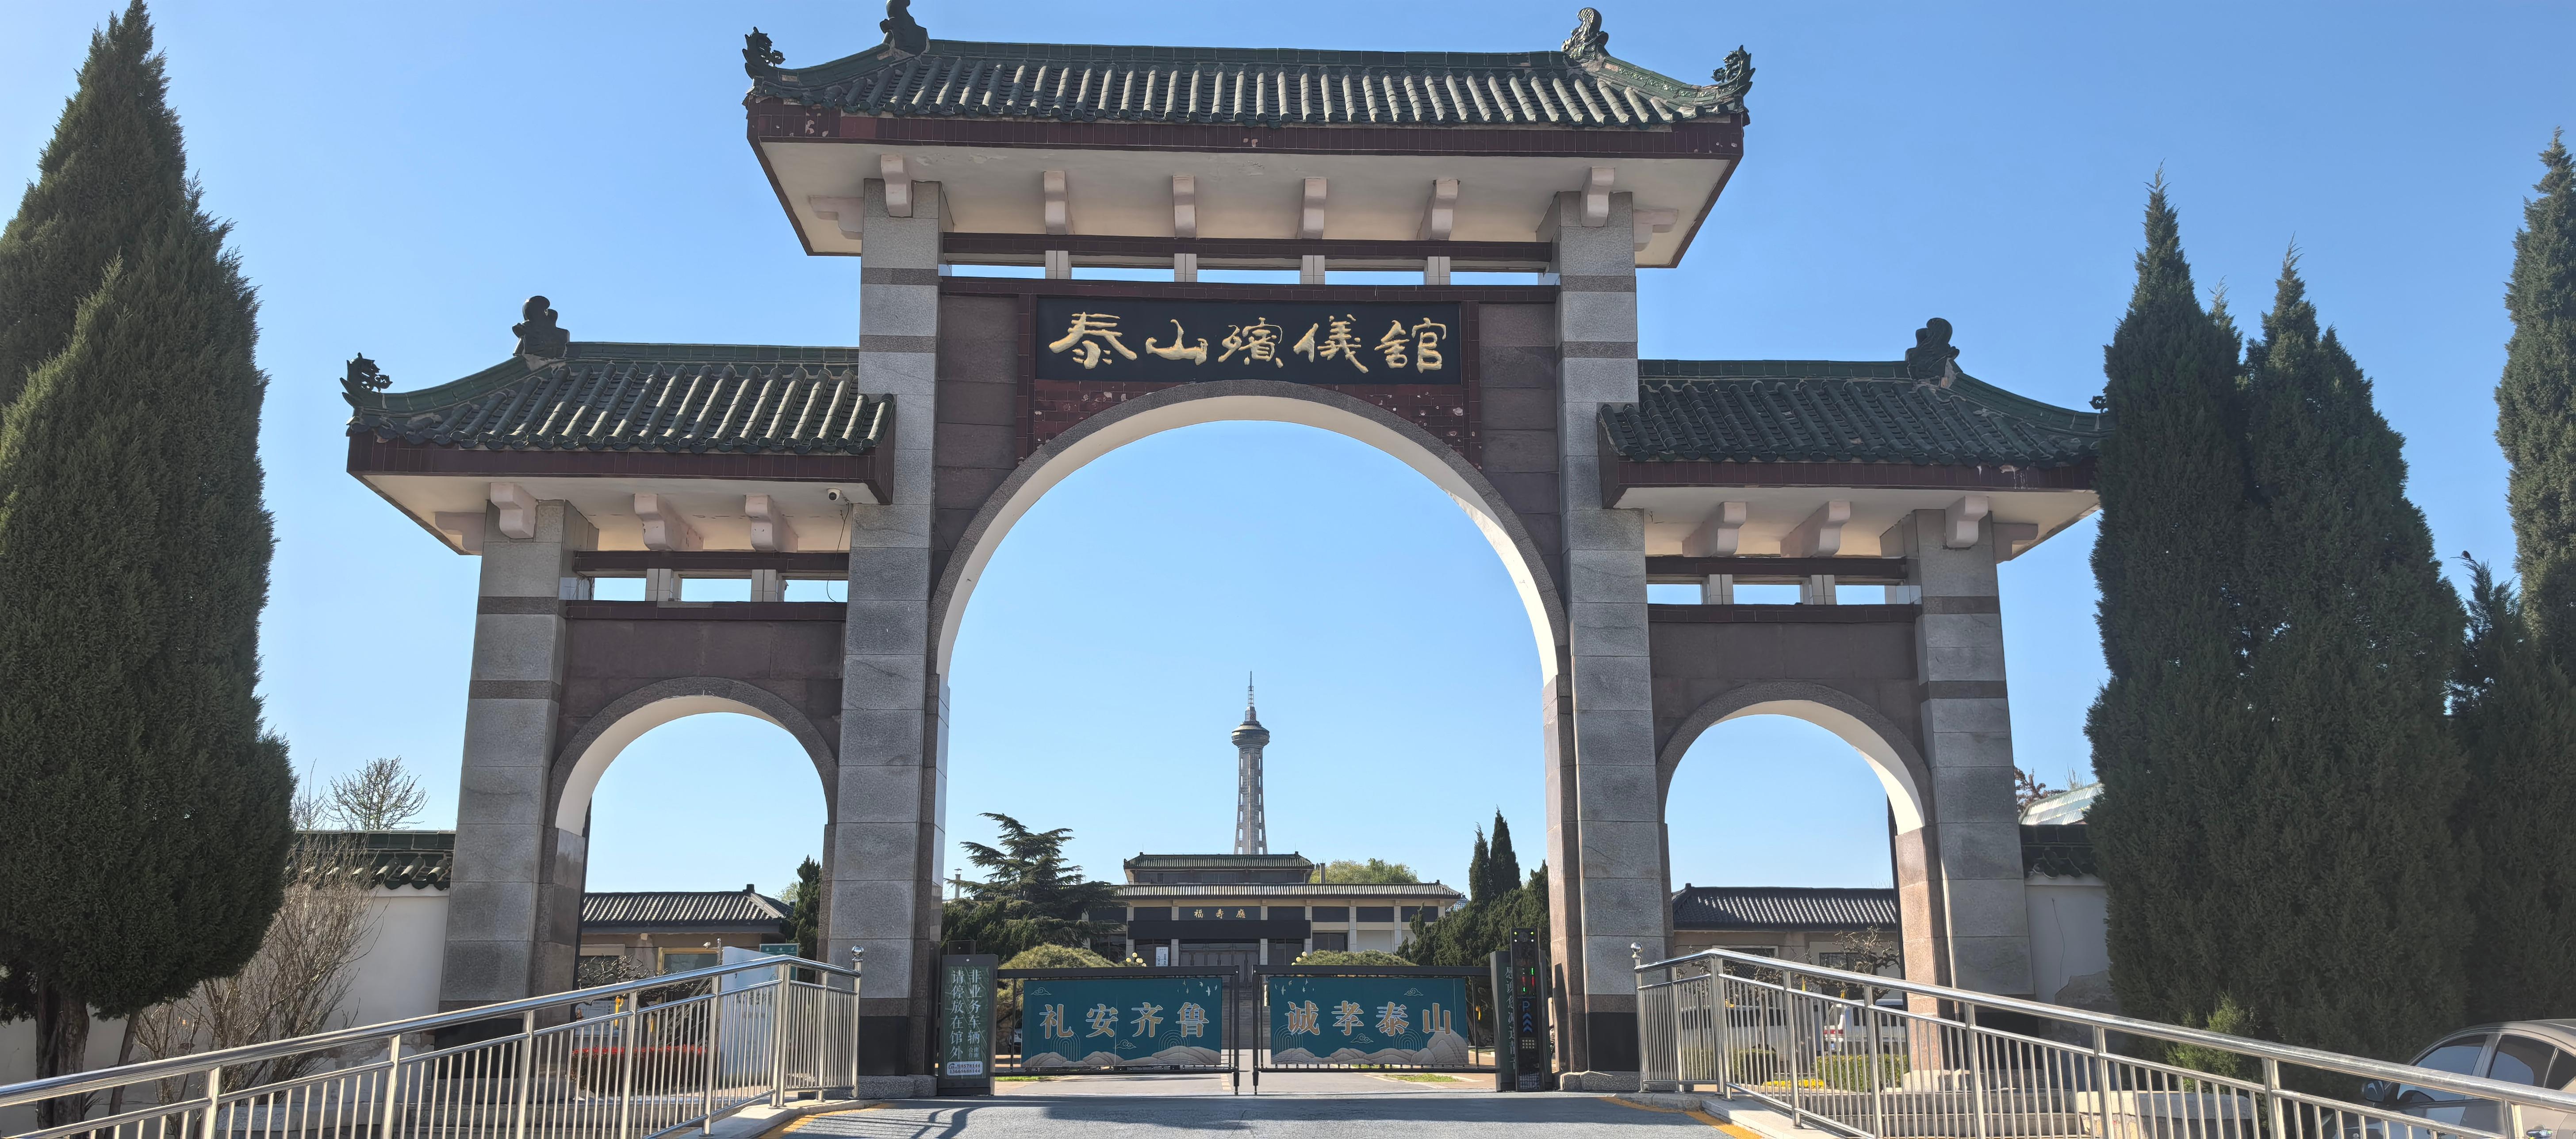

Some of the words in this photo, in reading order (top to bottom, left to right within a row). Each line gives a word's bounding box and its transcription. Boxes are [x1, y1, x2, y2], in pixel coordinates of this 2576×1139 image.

[949, 969, 964, 1060] 请停放在馆外
[967, 969, 982, 1044] 非业务车辆
[1039, 1002, 1209, 1038] 礼安齐鲁
[1285, 1000, 1453, 1036] 诚孝泰山
